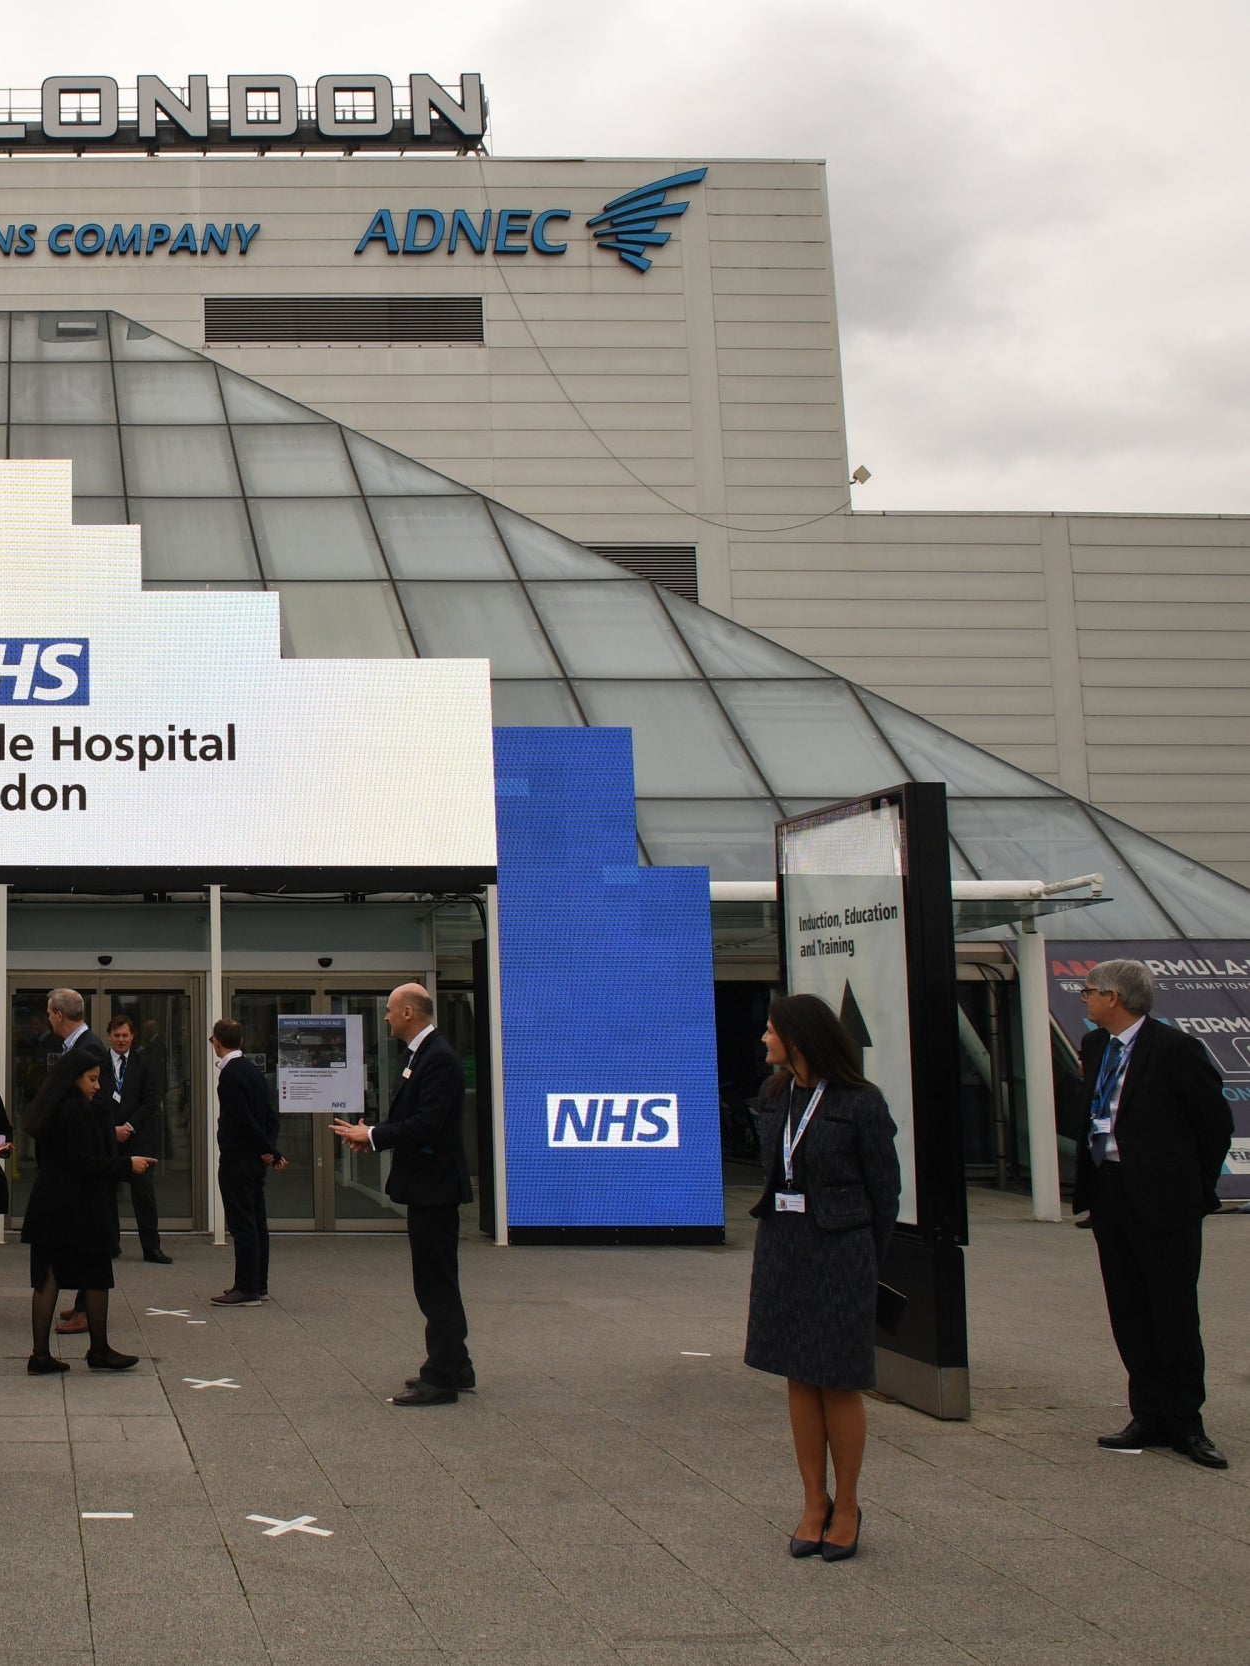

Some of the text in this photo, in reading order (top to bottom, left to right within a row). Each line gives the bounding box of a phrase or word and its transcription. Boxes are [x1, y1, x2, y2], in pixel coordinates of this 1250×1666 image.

[48, 223, 261, 255] COMPANY
[354, 209, 571, 254] ADNEC
[52, 723, 236, 771] Hospital
[799, 902, 898, 932] Induction, Education
[800, 936, 855, 957] and Training
[553, 1098, 671, 1142] NHS
